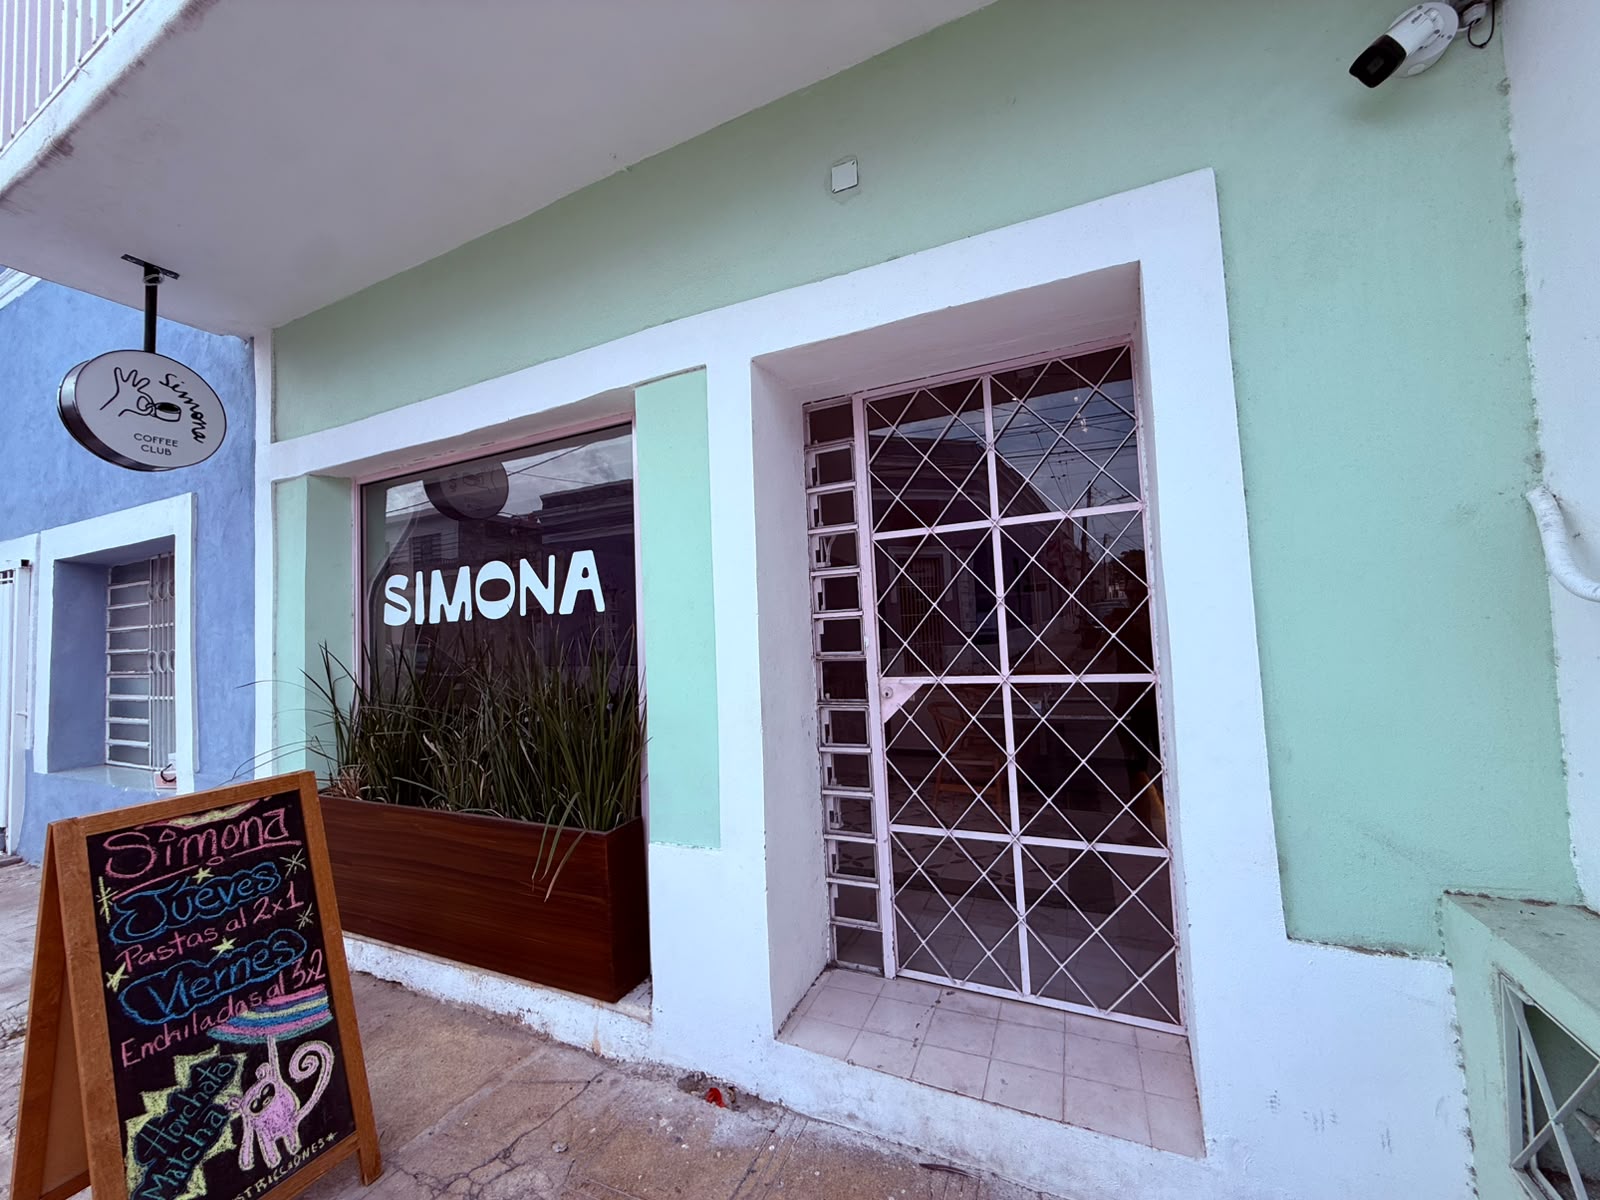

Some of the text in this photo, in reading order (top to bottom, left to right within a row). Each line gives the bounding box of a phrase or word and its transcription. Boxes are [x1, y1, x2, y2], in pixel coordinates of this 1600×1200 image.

[134, 433, 179, 448] COFFEE
[159, 373, 208, 444] Simona
[141, 444, 172, 456] CLUB
[383, 549, 606, 626] SIMONA
[103, 807, 289, 878] Simona
[115, 881, 304, 973] Pastas al 2x1
[147, 940, 296, 1015] Viernes
[121, 991, 263, 1068] Enchiladas
[267, 973, 286, 1000] al
